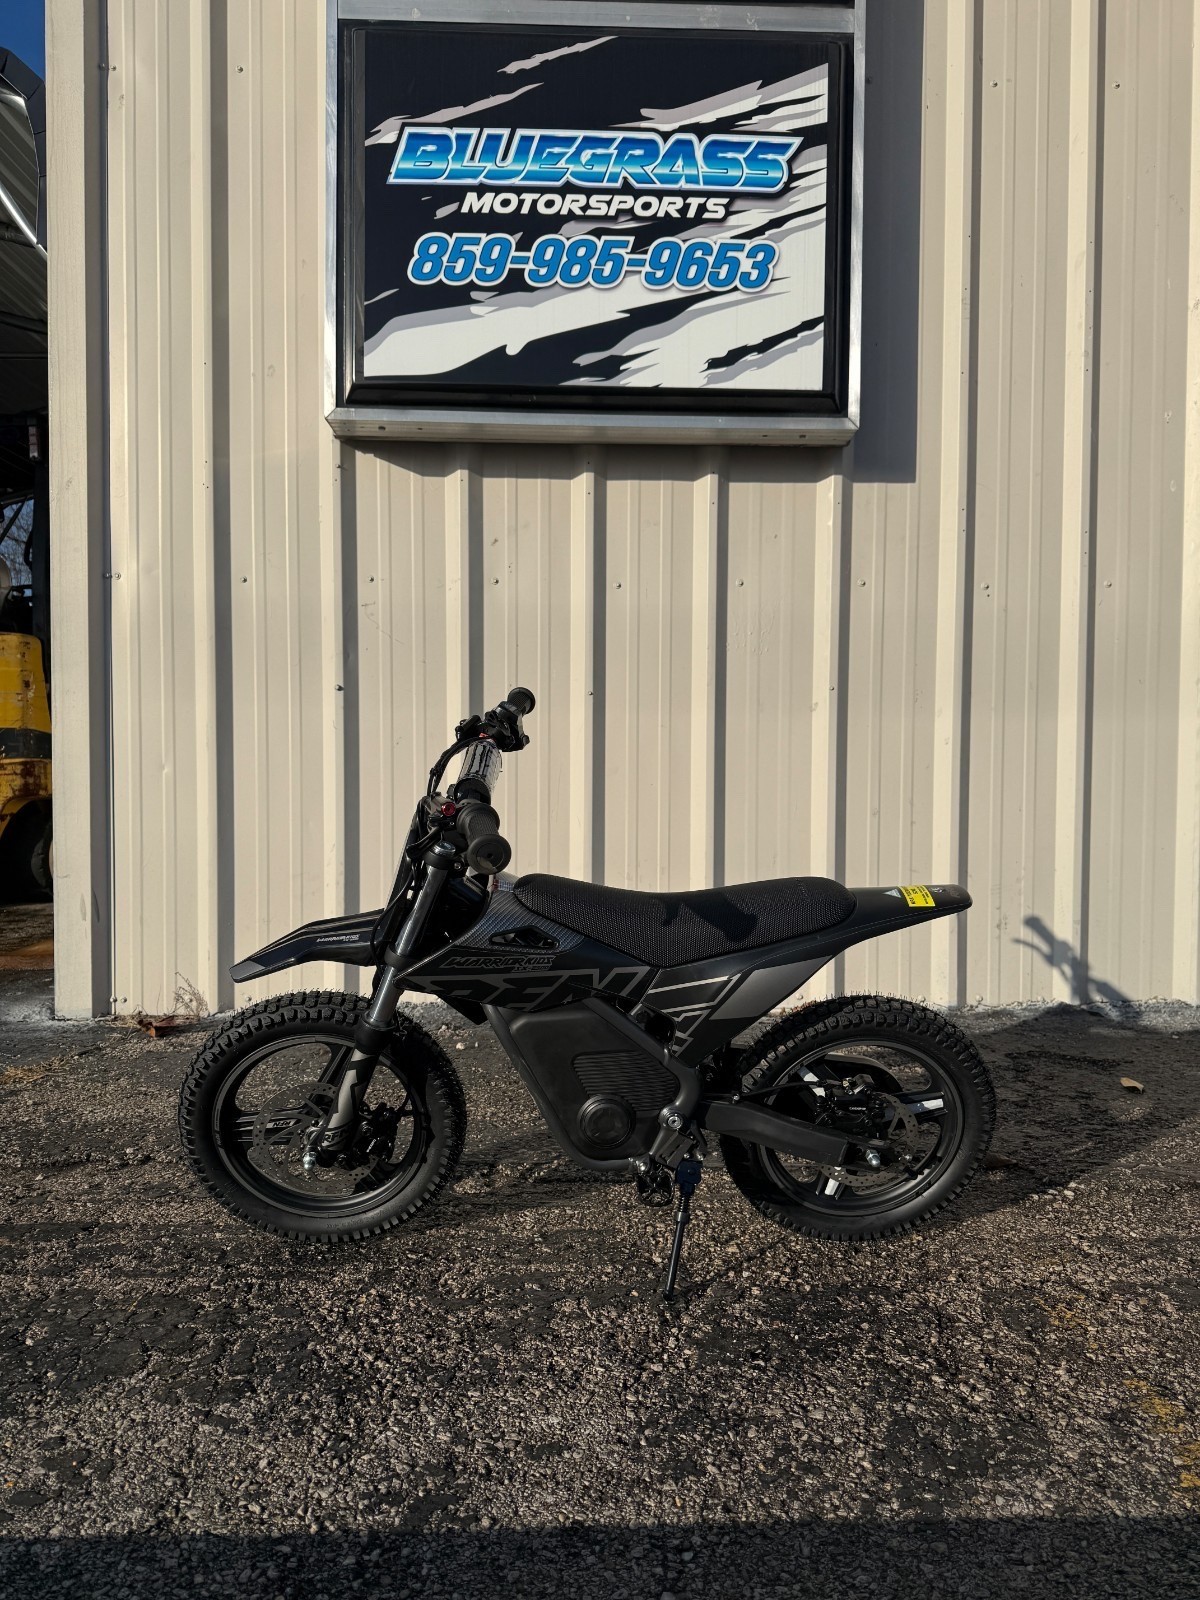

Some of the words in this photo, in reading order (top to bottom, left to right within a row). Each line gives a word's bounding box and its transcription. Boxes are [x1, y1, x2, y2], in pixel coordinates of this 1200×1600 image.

[387, 126, 803, 194] BLUEGRASS
[460, 191, 730, 220] MOTORSPORTS
[408, 232, 779, 293] 859-985-9653
